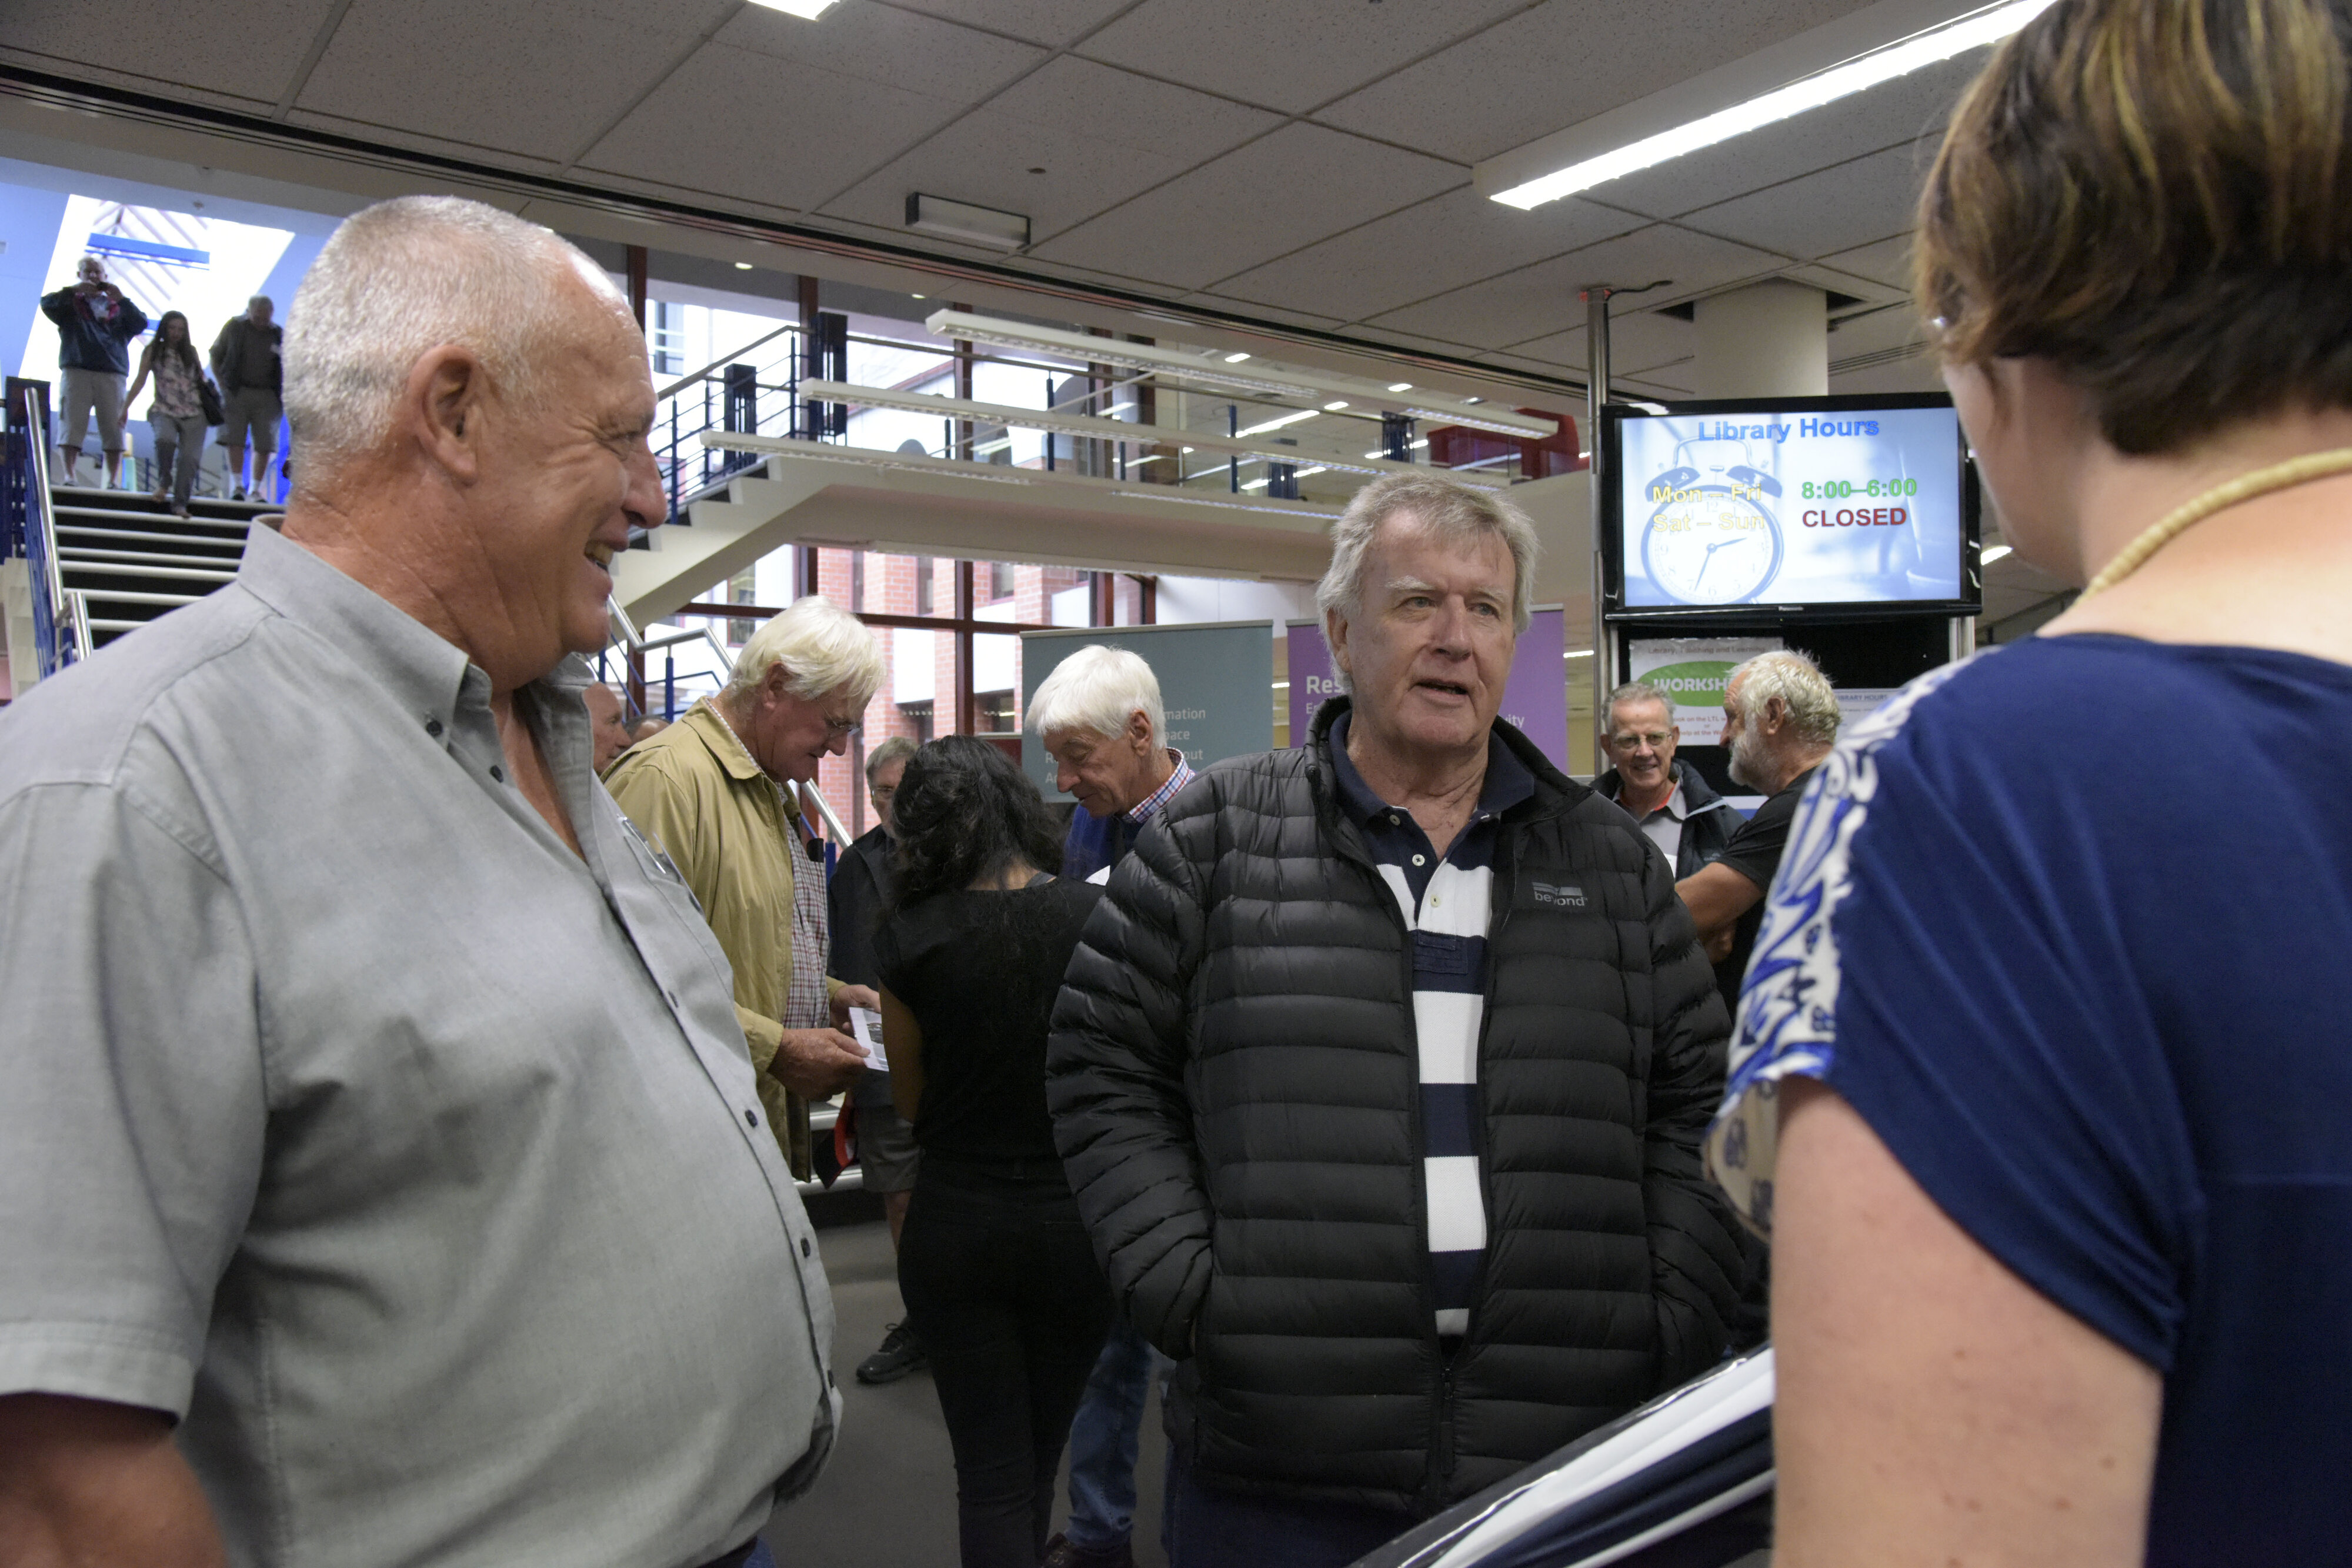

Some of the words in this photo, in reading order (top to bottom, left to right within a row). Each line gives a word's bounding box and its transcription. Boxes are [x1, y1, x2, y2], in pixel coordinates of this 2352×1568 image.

[1699, 421, 1791, 444] Library
[1800, 418, 1880, 438] Hours
[1652, 485, 1703, 504] Mon
[1730, 483, 1762, 501] Fri
[1653, 514, 1691, 532] Sat
[1719, 513, 1766, 530] Sun
[1802, 508, 1907, 528] CLOSED
